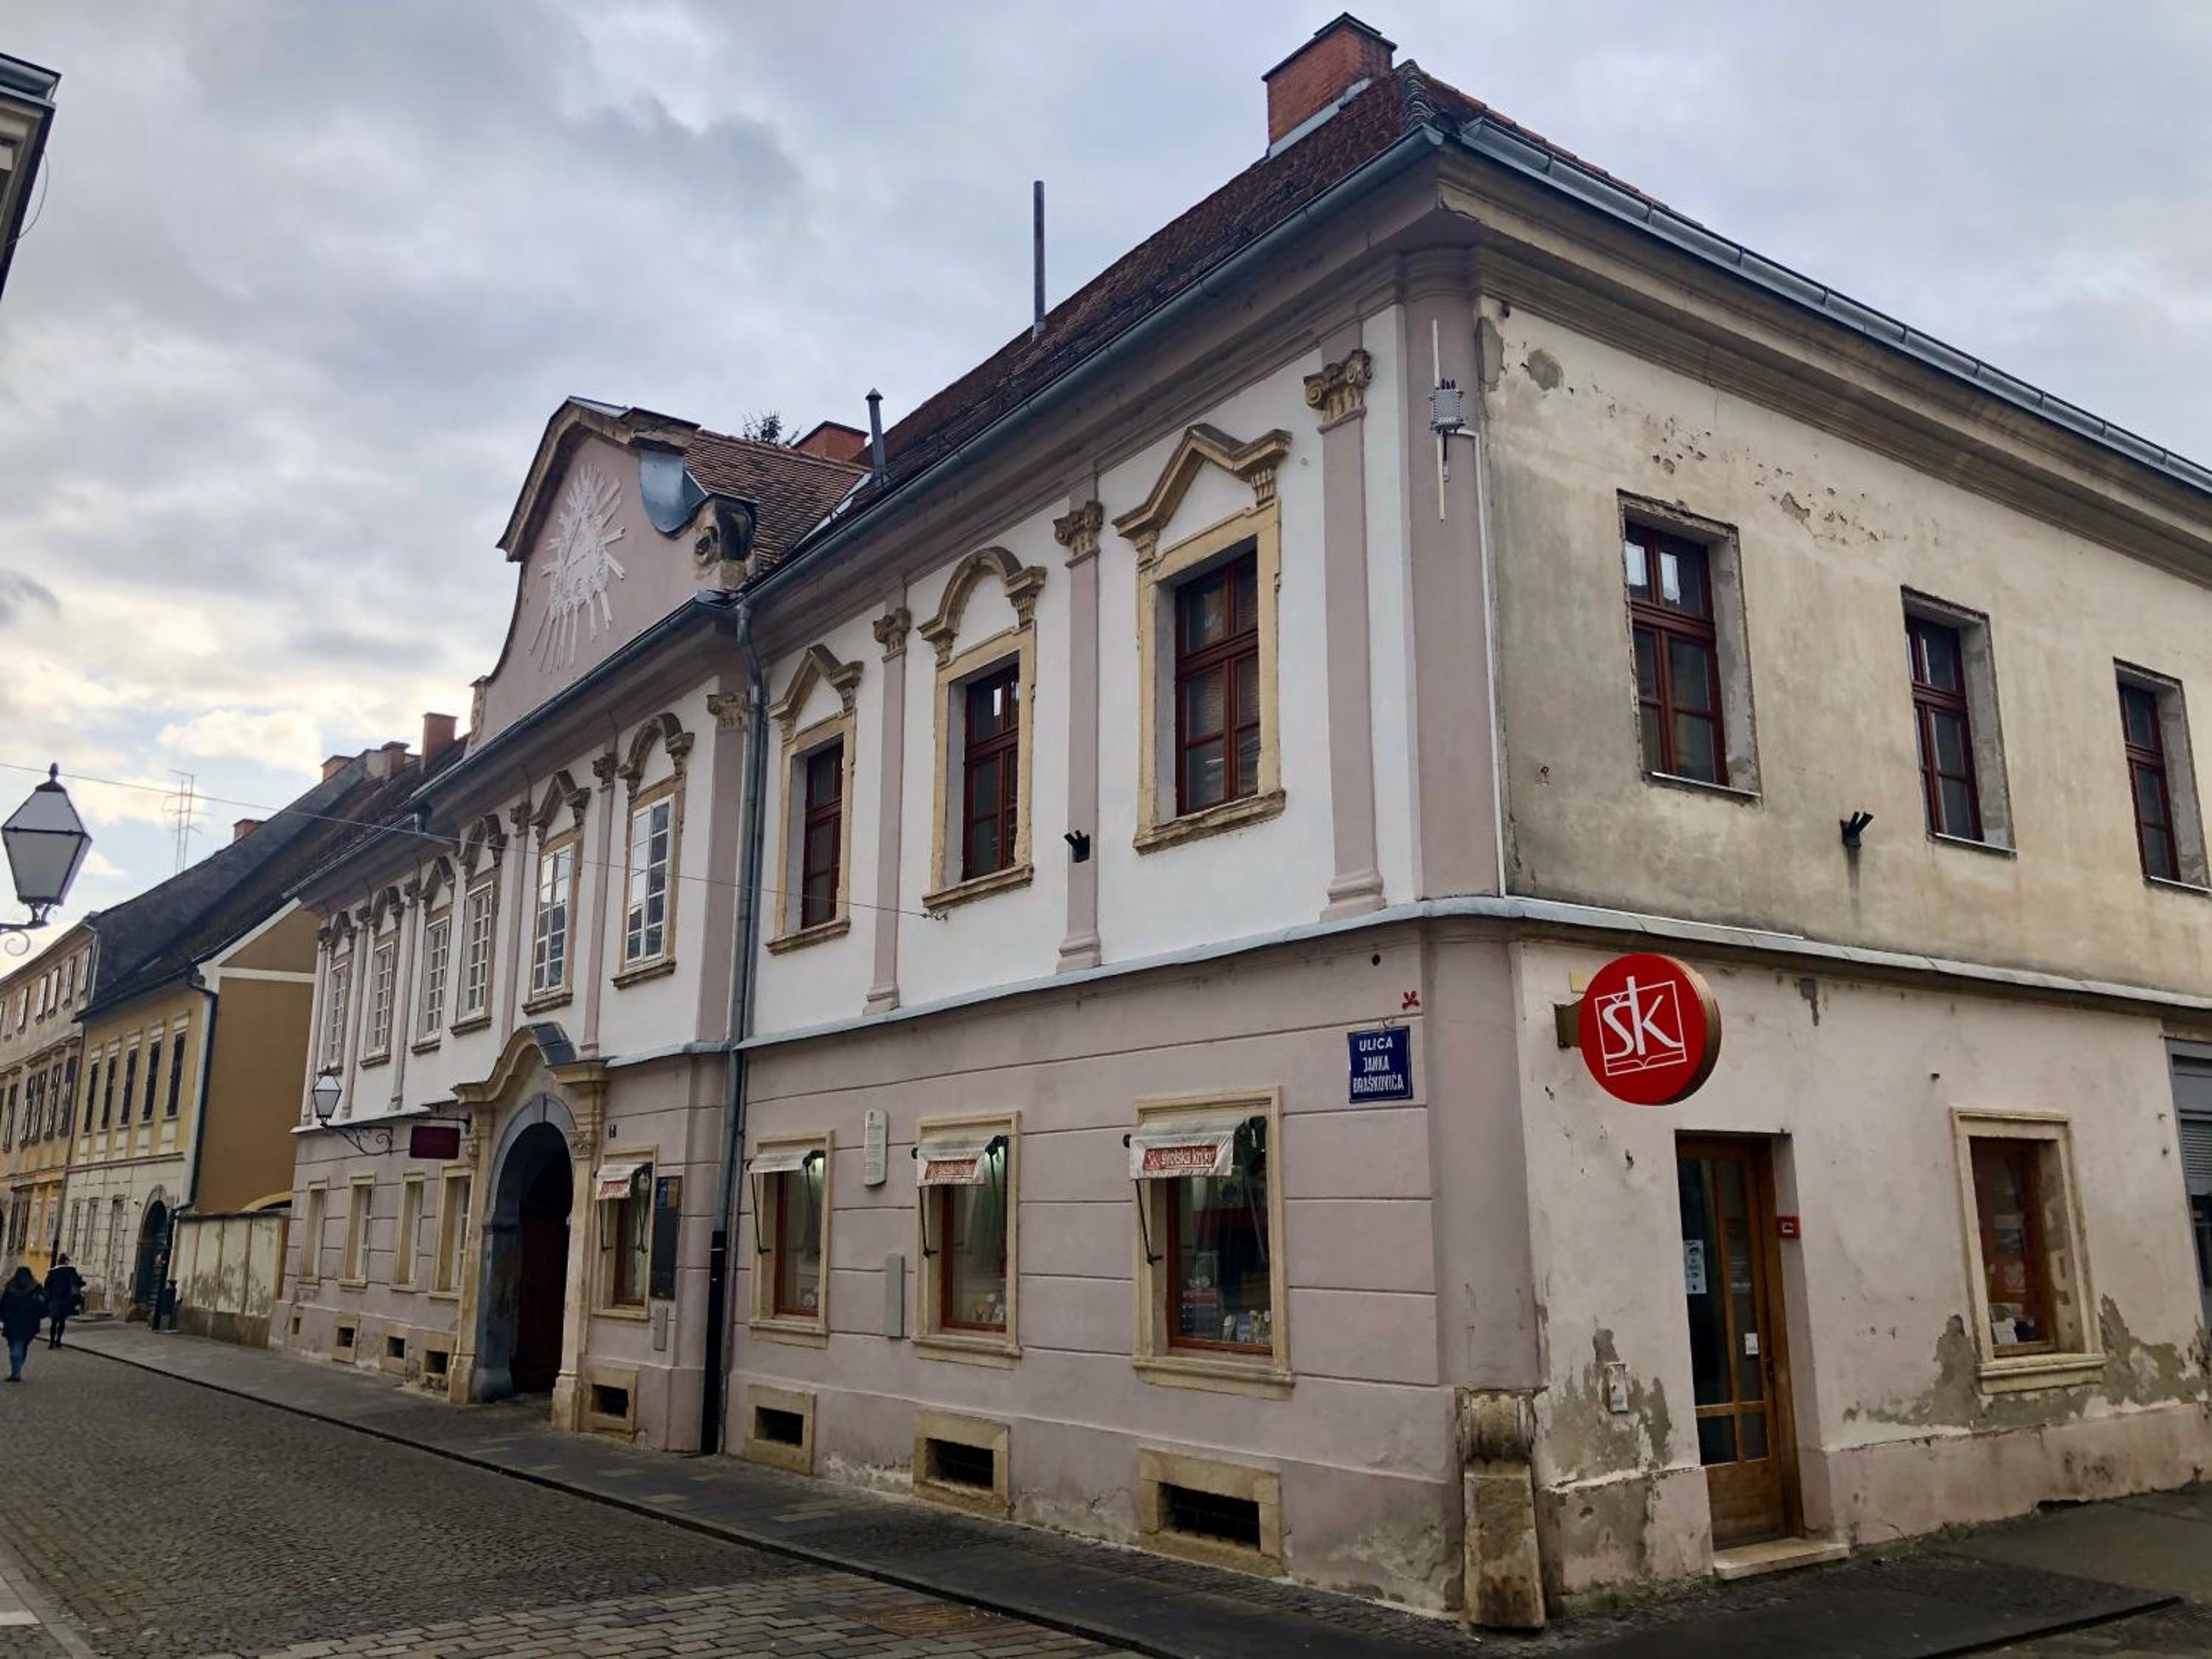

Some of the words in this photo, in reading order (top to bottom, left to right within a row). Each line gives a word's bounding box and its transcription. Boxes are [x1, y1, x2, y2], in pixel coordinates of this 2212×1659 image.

[1359, 1037, 1393, 1052] ULICA
[1363, 1055, 1390, 1072] JANKA
[1353, 1072, 1404, 1093] DRAŠKOVIĆA
